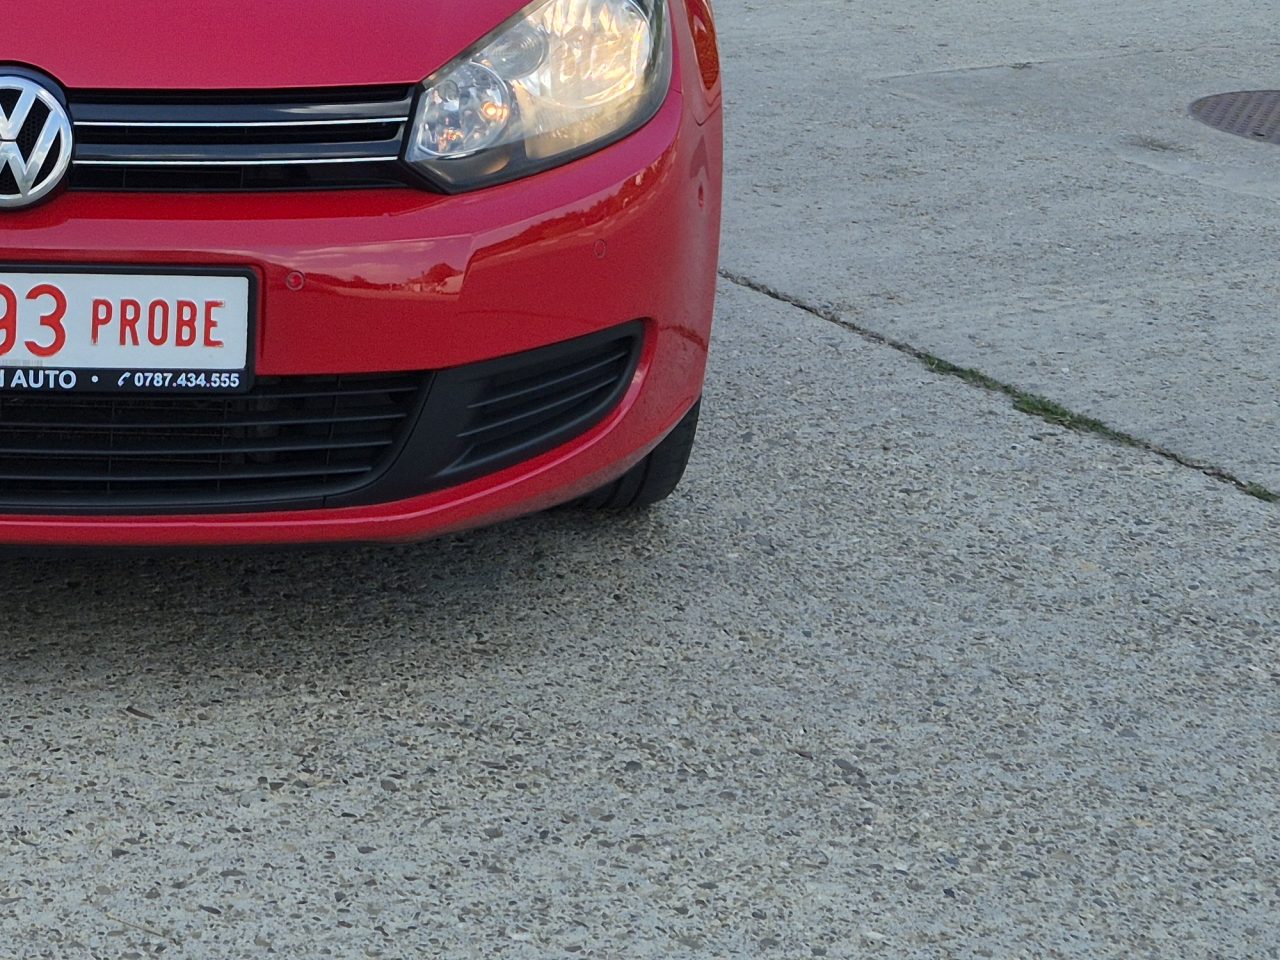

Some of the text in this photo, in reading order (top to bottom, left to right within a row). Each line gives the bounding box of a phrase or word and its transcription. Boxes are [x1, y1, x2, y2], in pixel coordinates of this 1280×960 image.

[90, 298, 226, 348] PROBE
[10, 369, 77, 389] AUTO
[133, 372, 240, 389] 0787.434.555
